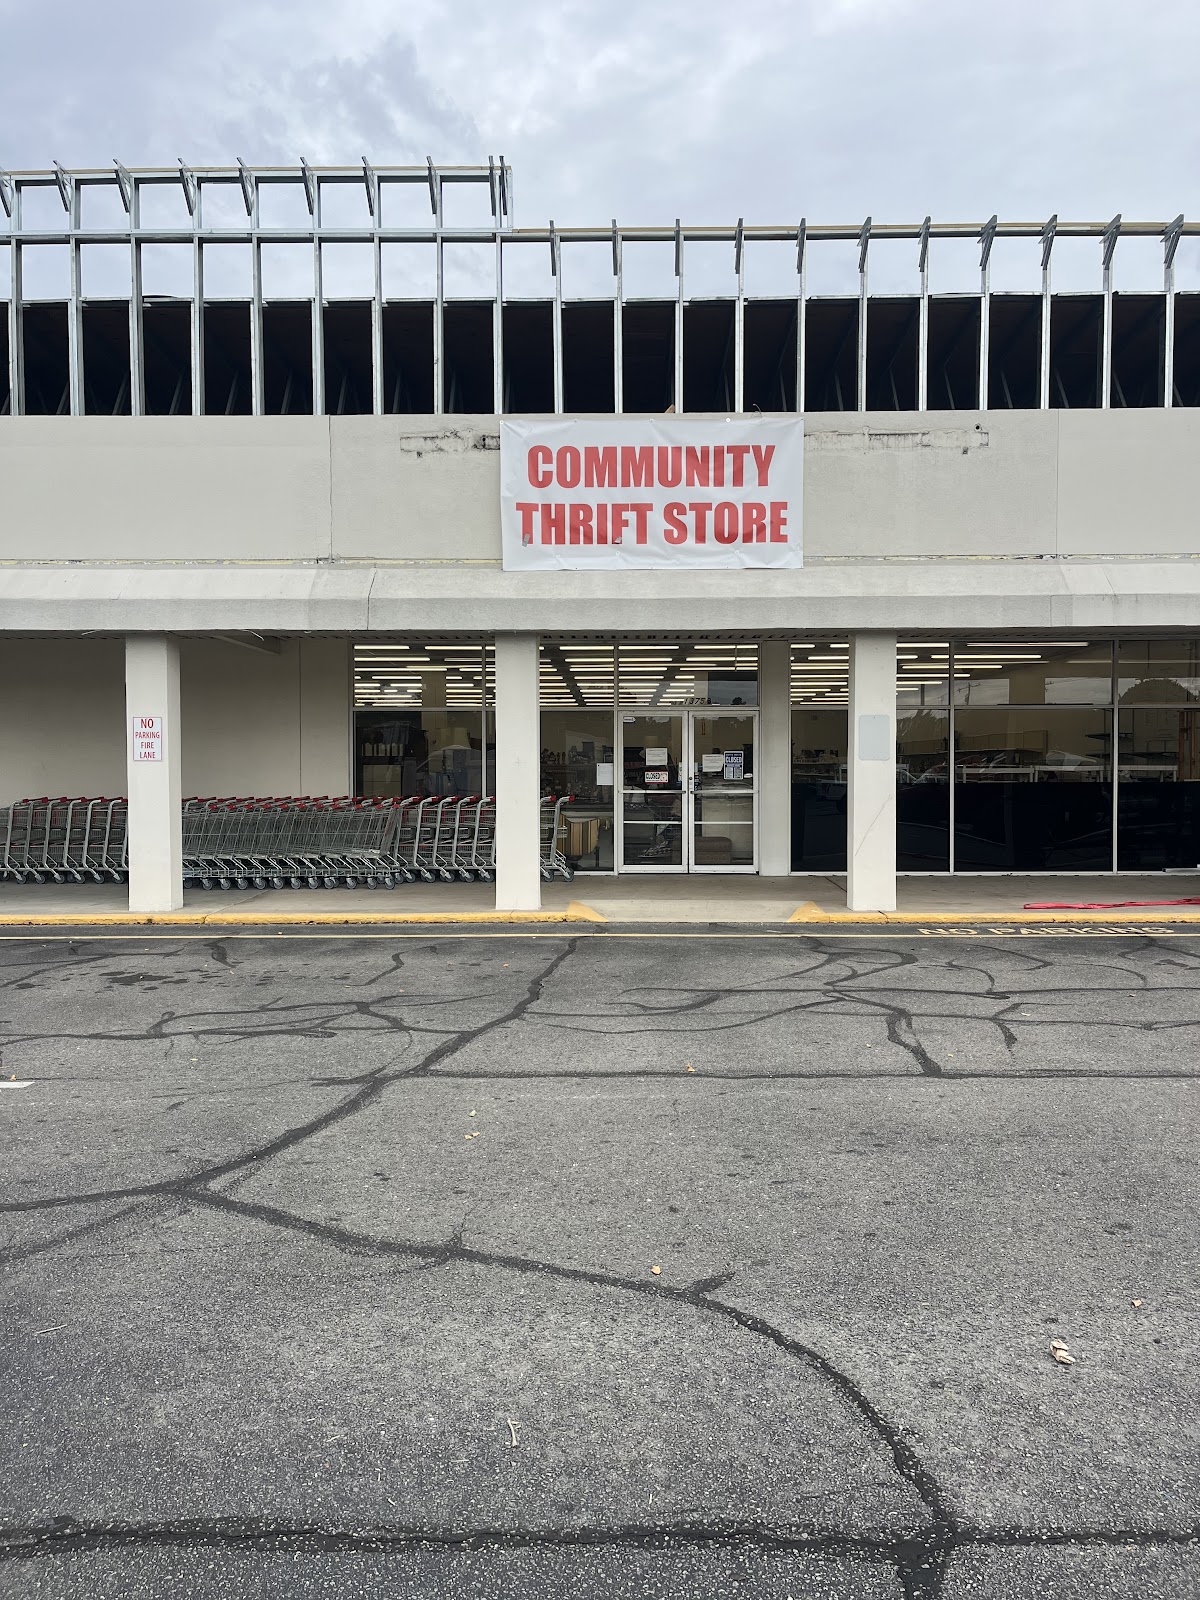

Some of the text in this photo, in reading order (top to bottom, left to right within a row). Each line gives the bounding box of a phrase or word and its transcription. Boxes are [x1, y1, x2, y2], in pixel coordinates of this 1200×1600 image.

[528, 445, 775, 488] COMMUNITY
[516, 502, 788, 544] THRIFT STORE
[141, 718, 154, 729] NO
[135, 731, 160, 739] PARKING
[141, 741, 154, 749] FIRE
[140, 751, 156, 759] LANE
[645, 772, 661, 780] CLOSED
[988, 927, 1175, 935] PARKING
